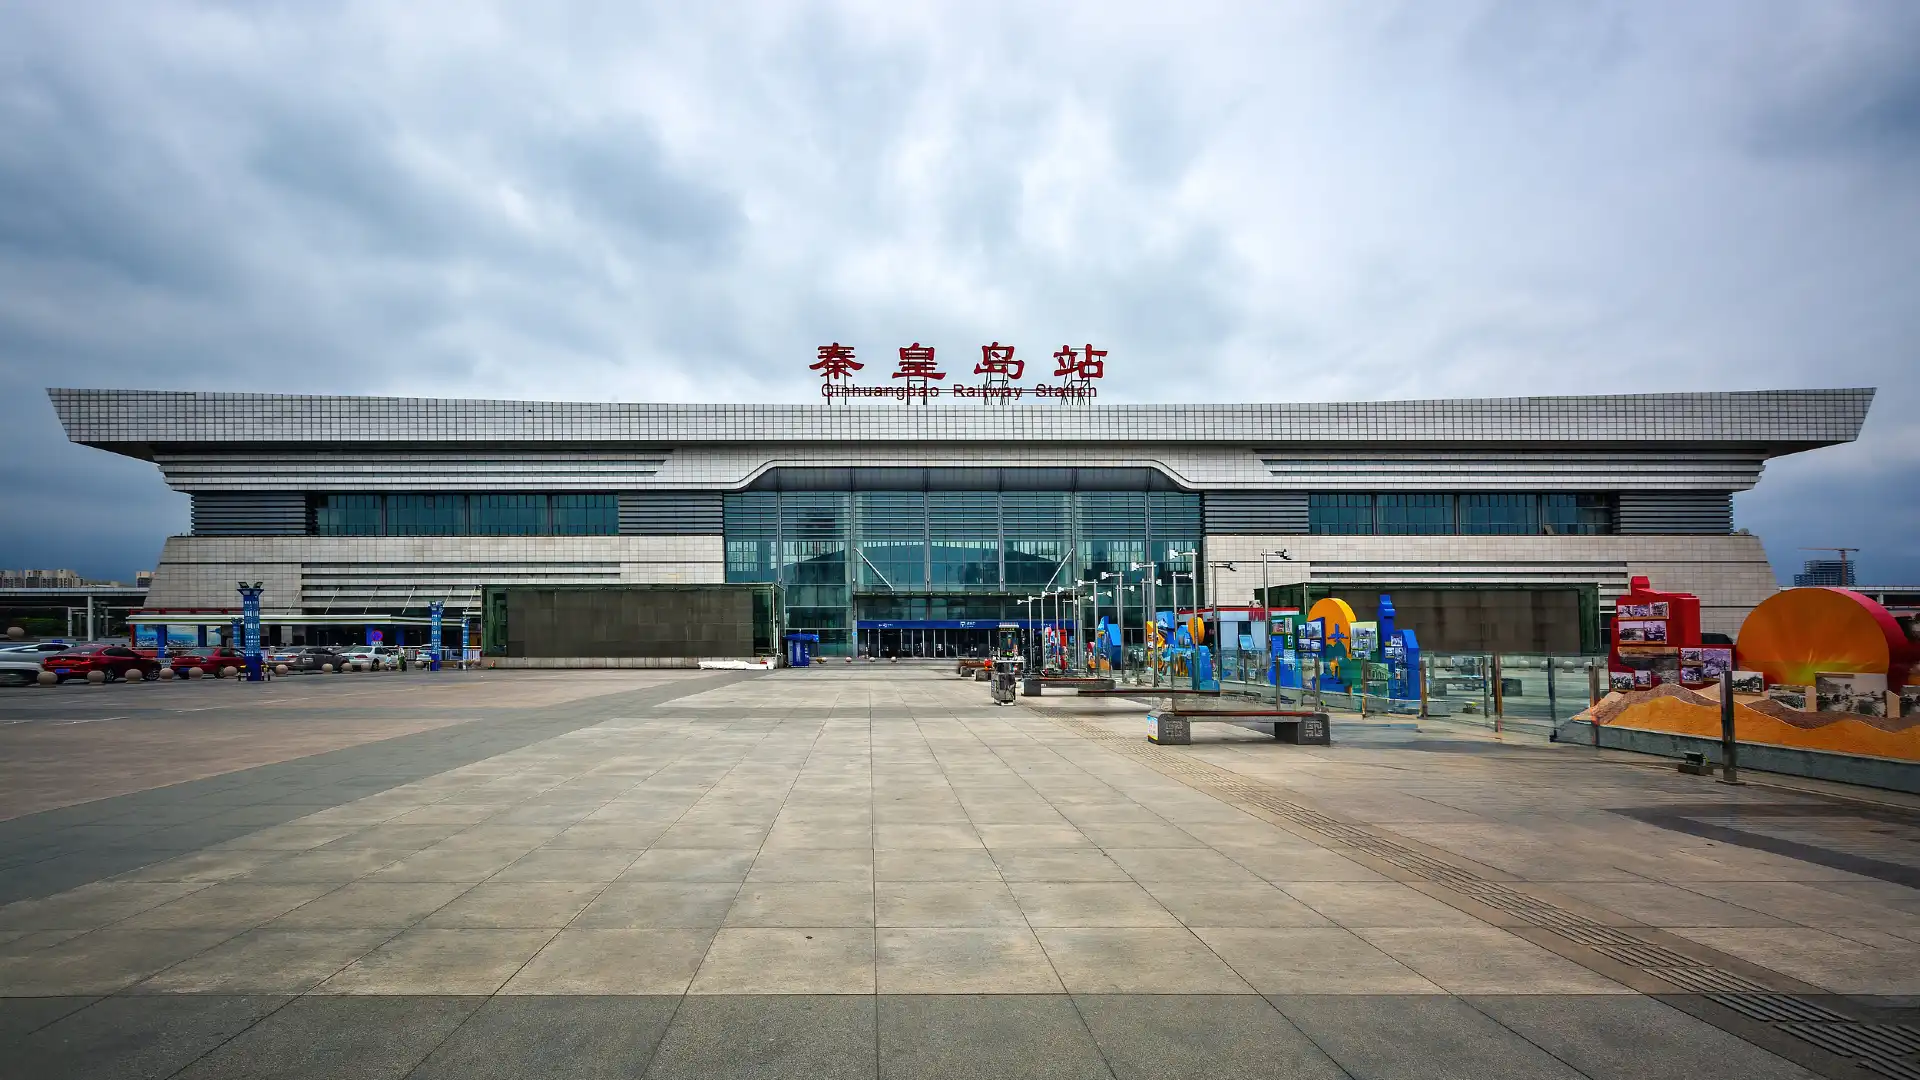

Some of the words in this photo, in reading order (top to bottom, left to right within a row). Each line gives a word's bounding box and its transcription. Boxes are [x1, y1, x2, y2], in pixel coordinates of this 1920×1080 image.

[809, 342, 1107, 379] 秦皇岛站
[821, 383, 939, 400] Qinhuangdao
[953, 384, 1022, 400] Railway
[1036, 383, 1097, 397] Station
